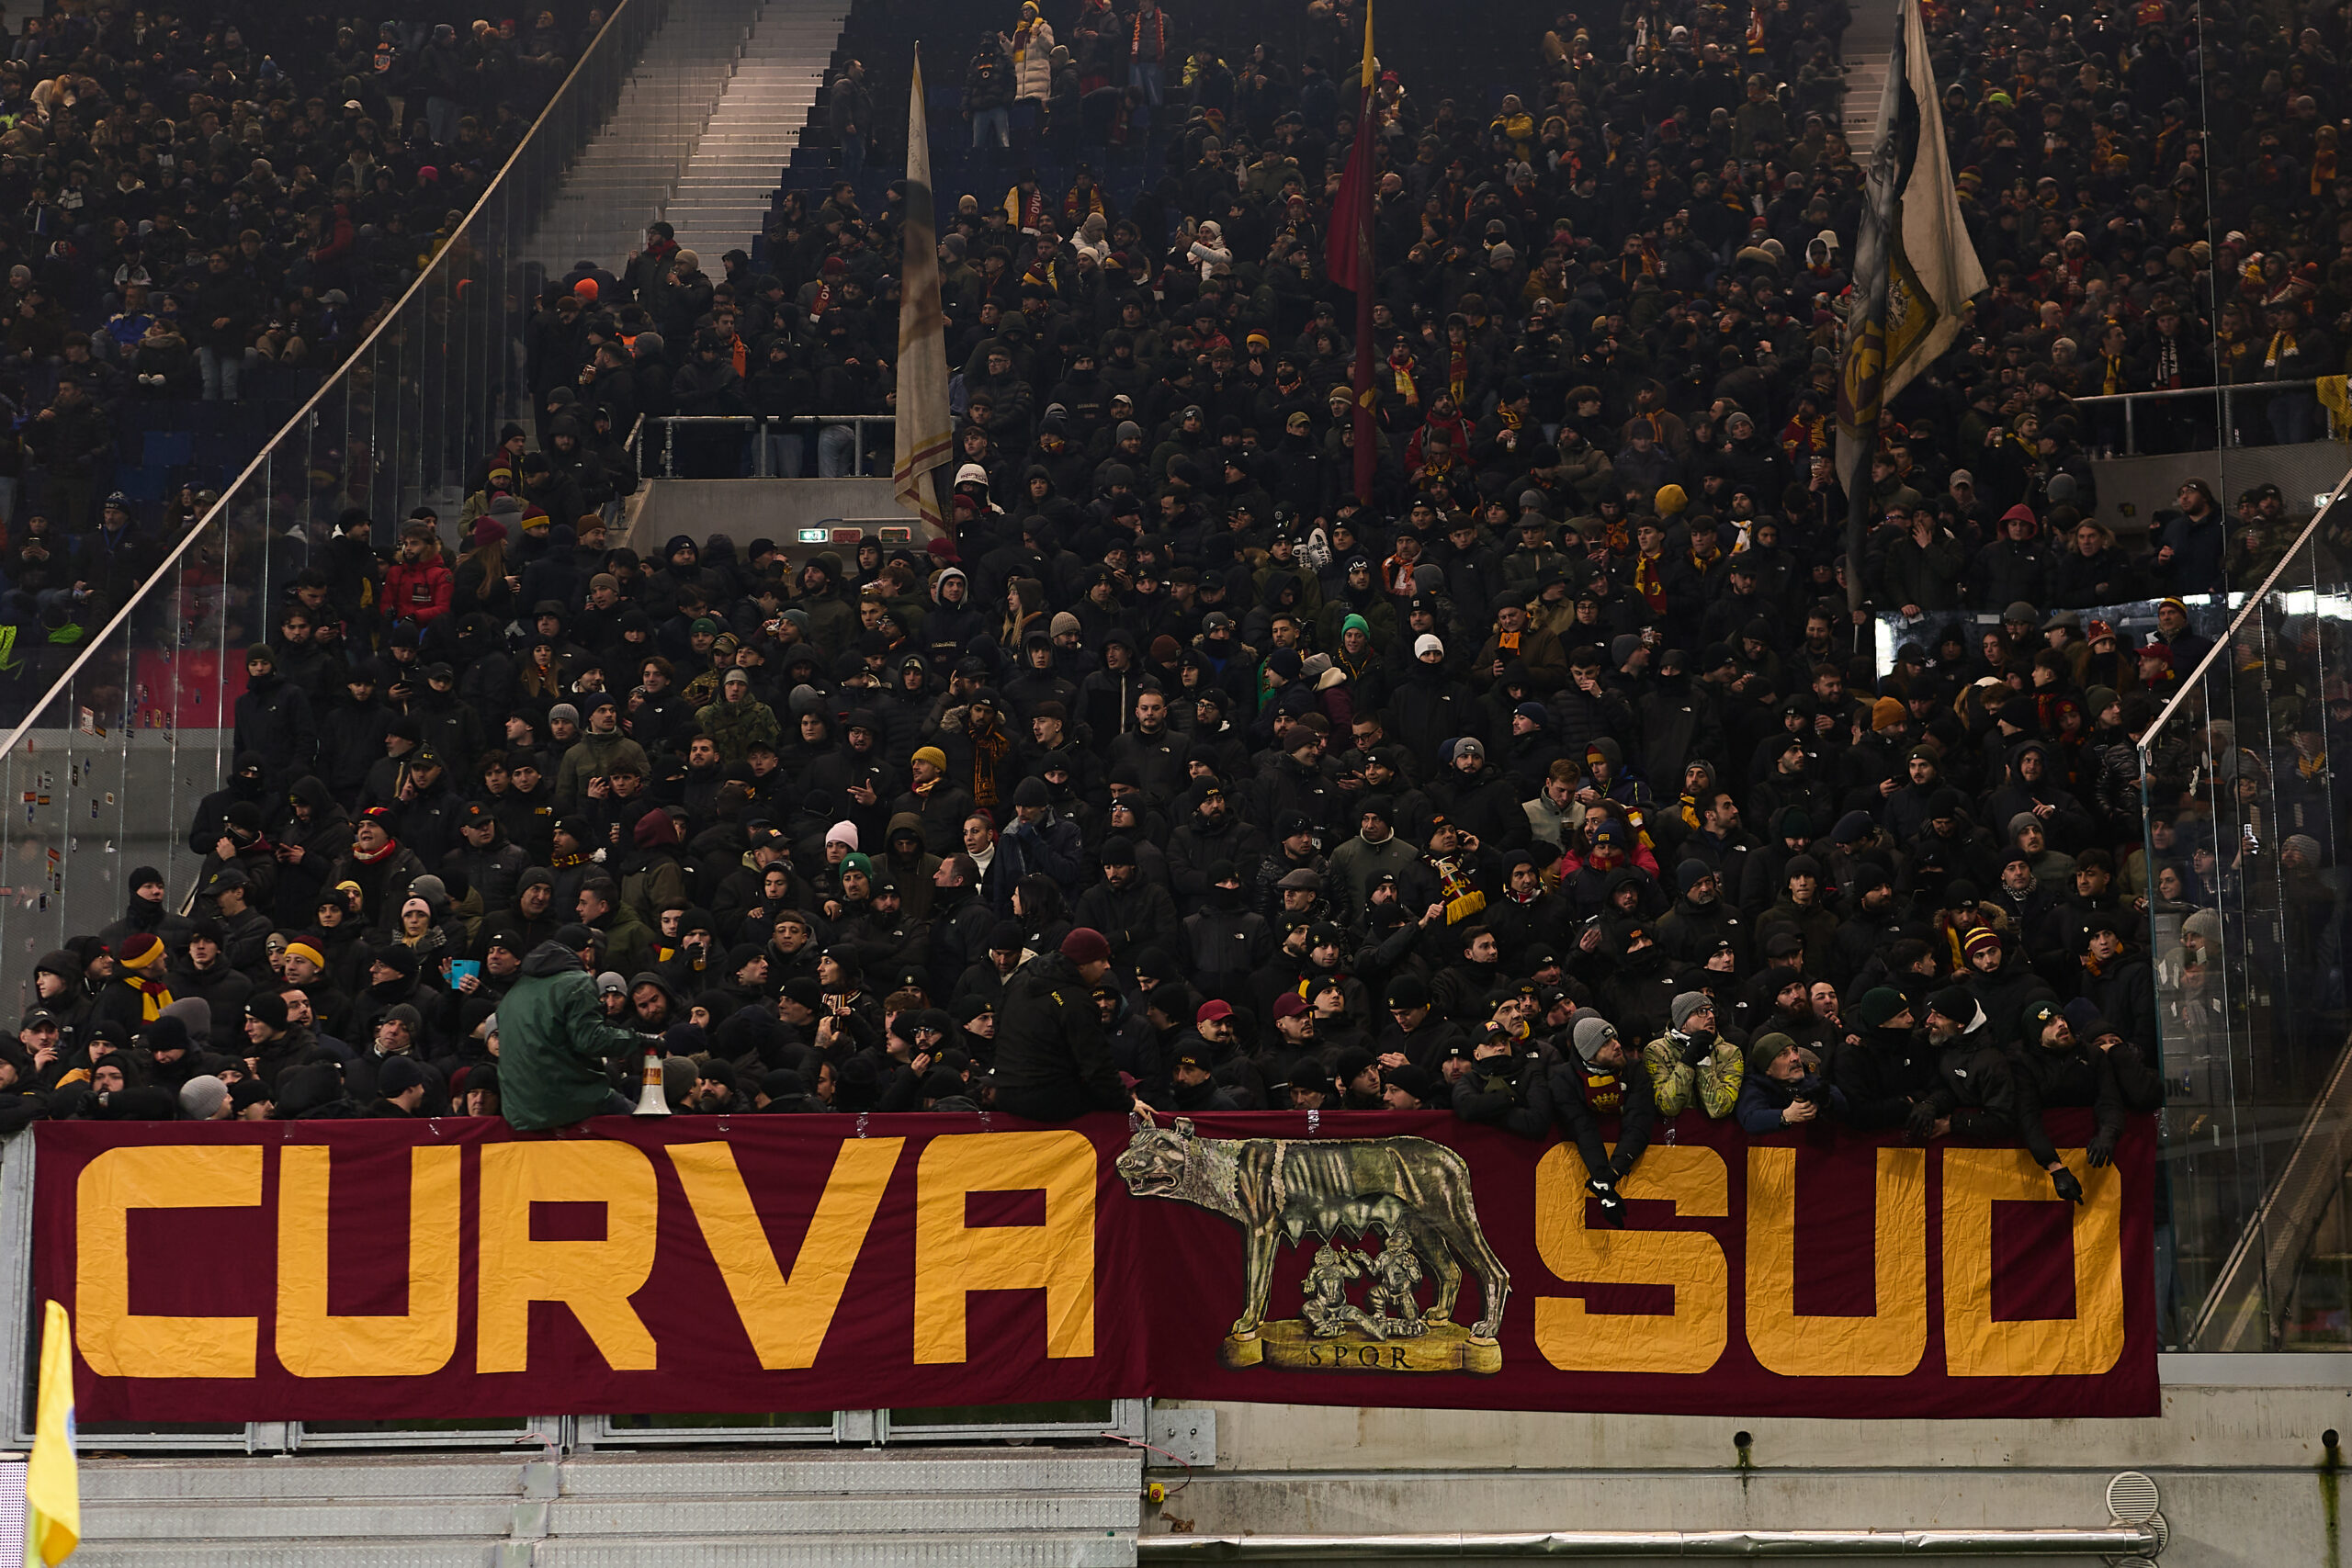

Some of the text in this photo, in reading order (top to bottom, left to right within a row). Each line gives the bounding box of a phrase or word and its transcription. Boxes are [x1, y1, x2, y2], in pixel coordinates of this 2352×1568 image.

[1051, 990, 1065, 1007] ROMA
[75, 1130, 2125, 1379] CURVA SUD
[1310, 1346, 1414, 1369] SPQR
